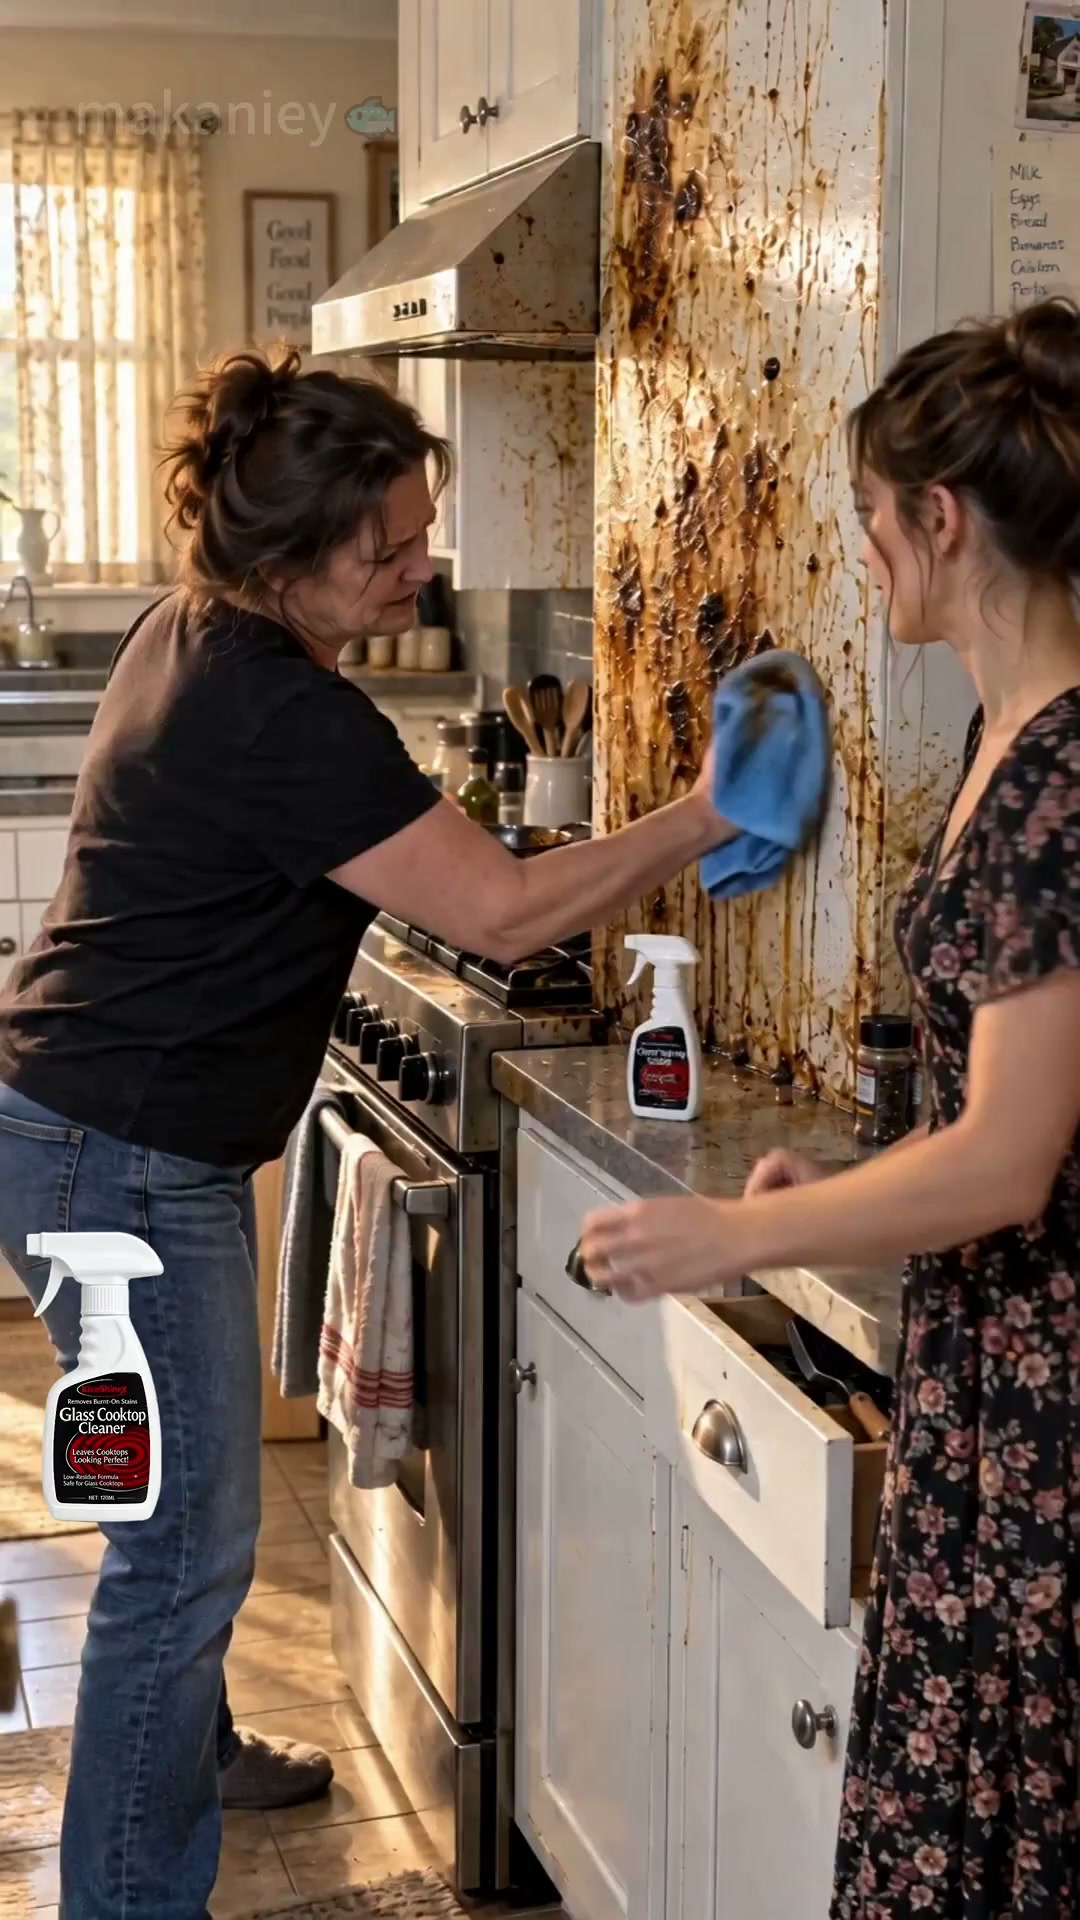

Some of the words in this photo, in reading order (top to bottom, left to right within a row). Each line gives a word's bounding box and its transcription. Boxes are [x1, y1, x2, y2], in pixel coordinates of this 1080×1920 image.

[266, 218, 312, 241] Good
[268, 246, 311, 268] Food
[59, 1407, 95, 1422] Glass
[97, 1407, 146, 1425] Cooktop
[78, 1422, 126, 1435] Cleaner
[72, 1448, 95, 1456] Leaves
[96, 1448, 128, 1457] Cooktops
[74, 1456, 102, 1464] Looking
[103, 1456, 129, 1464] Perfect!
